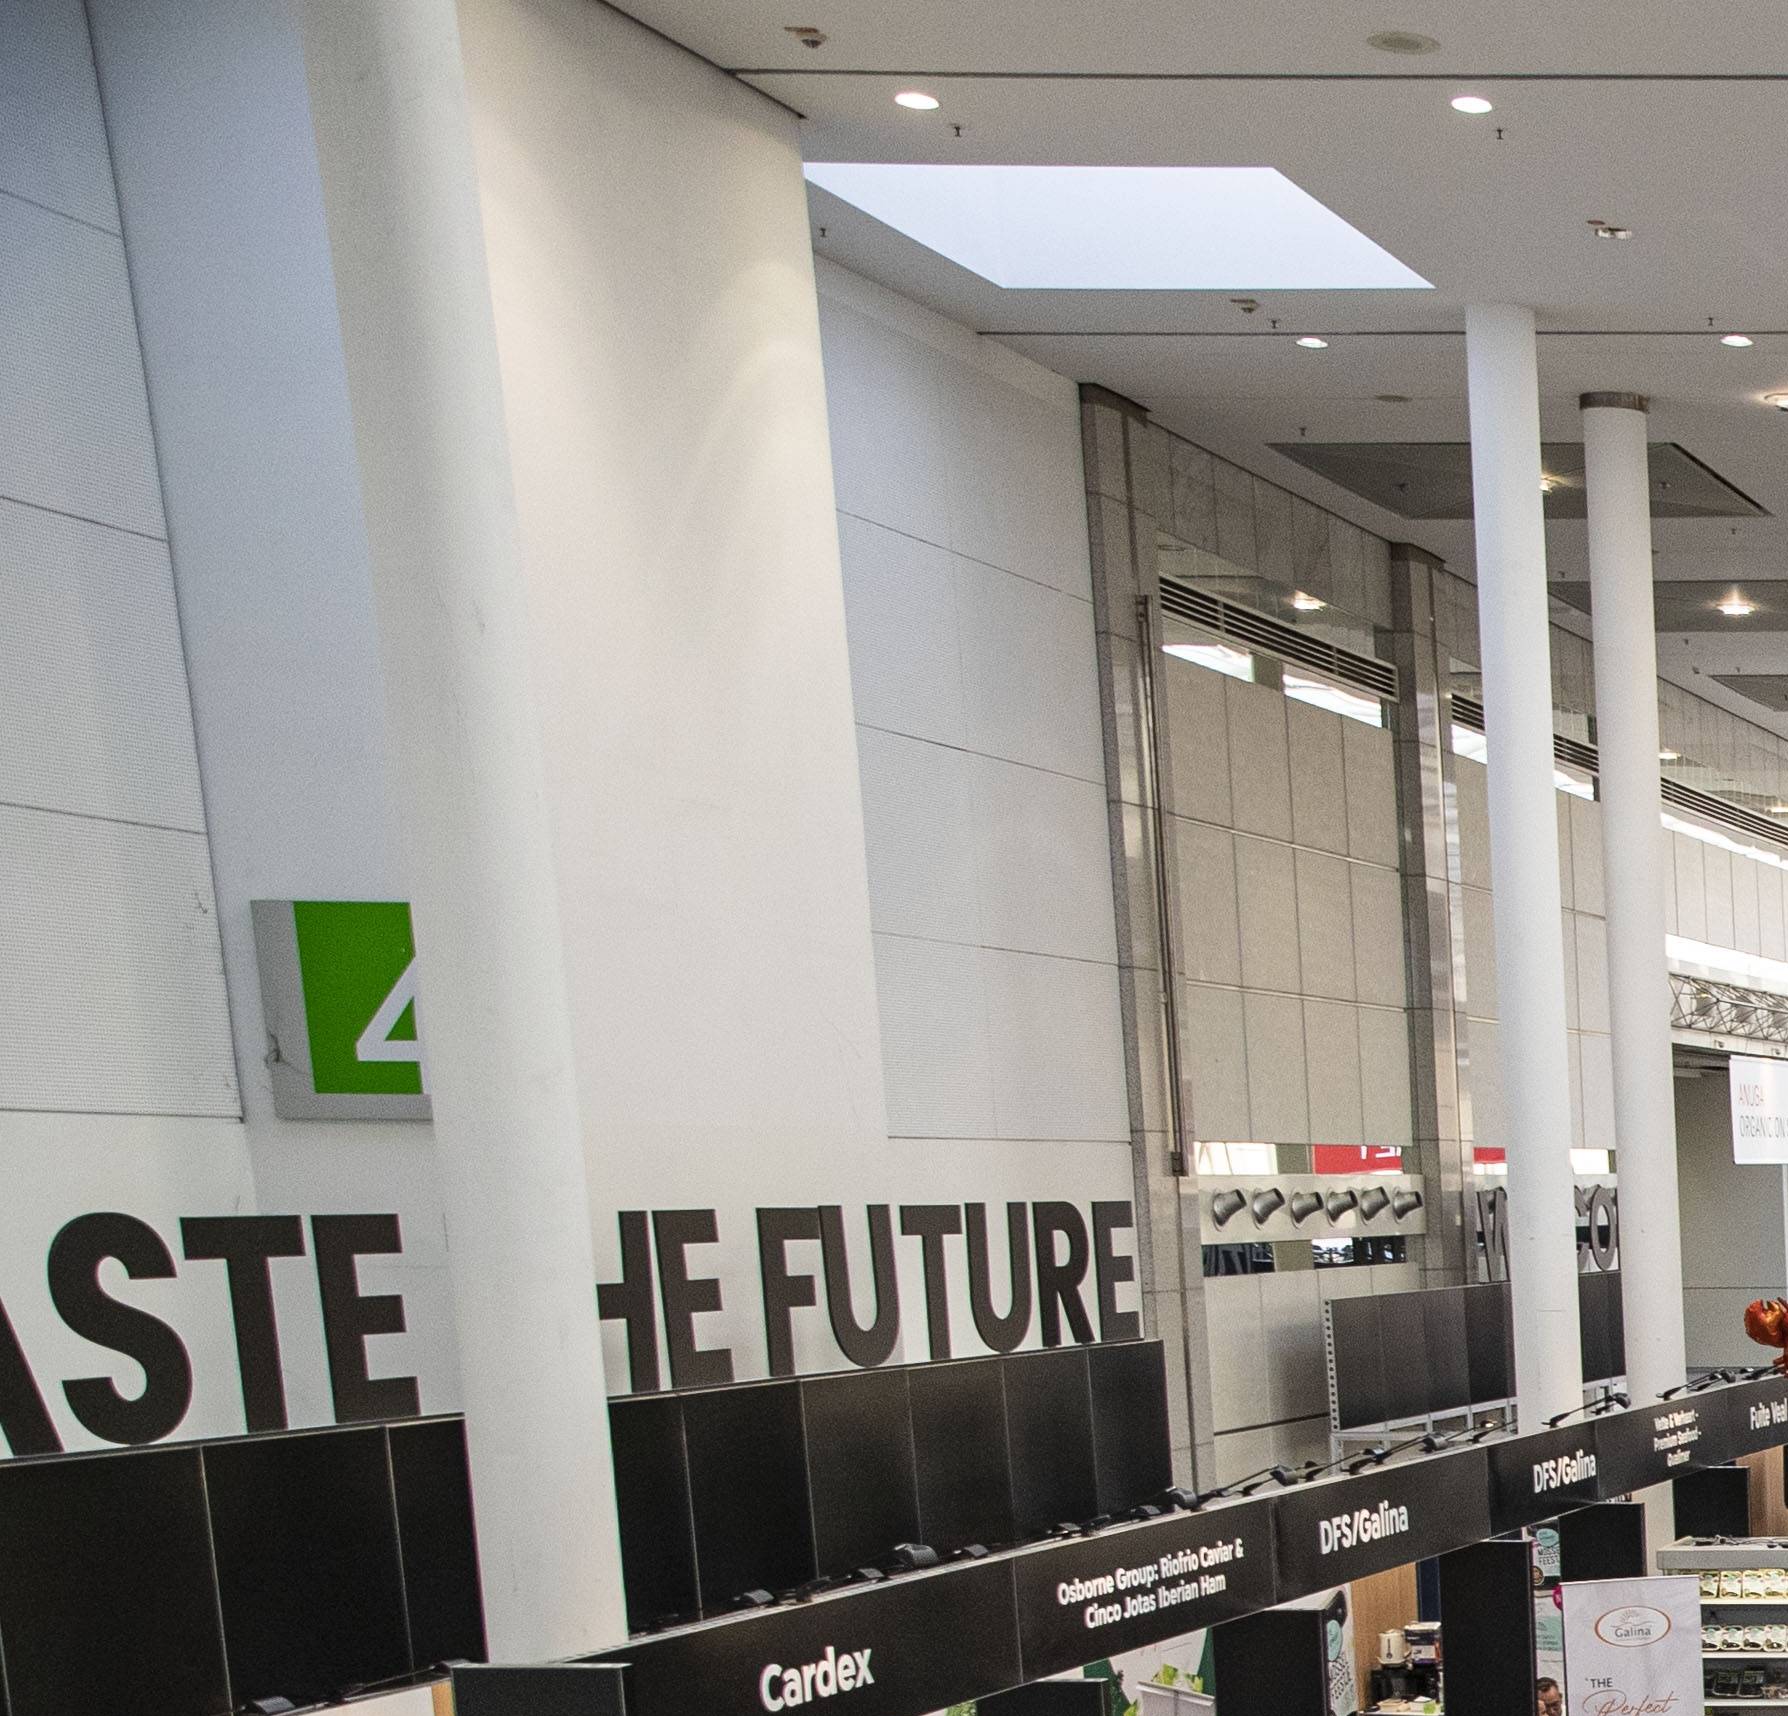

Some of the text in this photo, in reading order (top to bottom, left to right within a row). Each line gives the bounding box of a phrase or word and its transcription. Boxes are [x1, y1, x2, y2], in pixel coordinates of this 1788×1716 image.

[755, 1200, 1141, 1378] FUTURE
[1533, 1448, 1598, 1495] DFS/Galina
[1319, 1500, 1410, 1556] DFS/Galina
[1057, 1573, 1115, 1606] Osborne
[1115, 1562, 1159, 1590] Group:
[1199, 1540, 1235, 1569] Caviar
[1234, 1538, 1245, 1559] &
[1085, 1573, 1227, 1630] Cinco Jotas Iberian Ham
[1614, 1626, 1652, 1639] Galina
[759, 1645, 875, 1714] Cardex
[1590, 1677, 1613, 1689] THE
